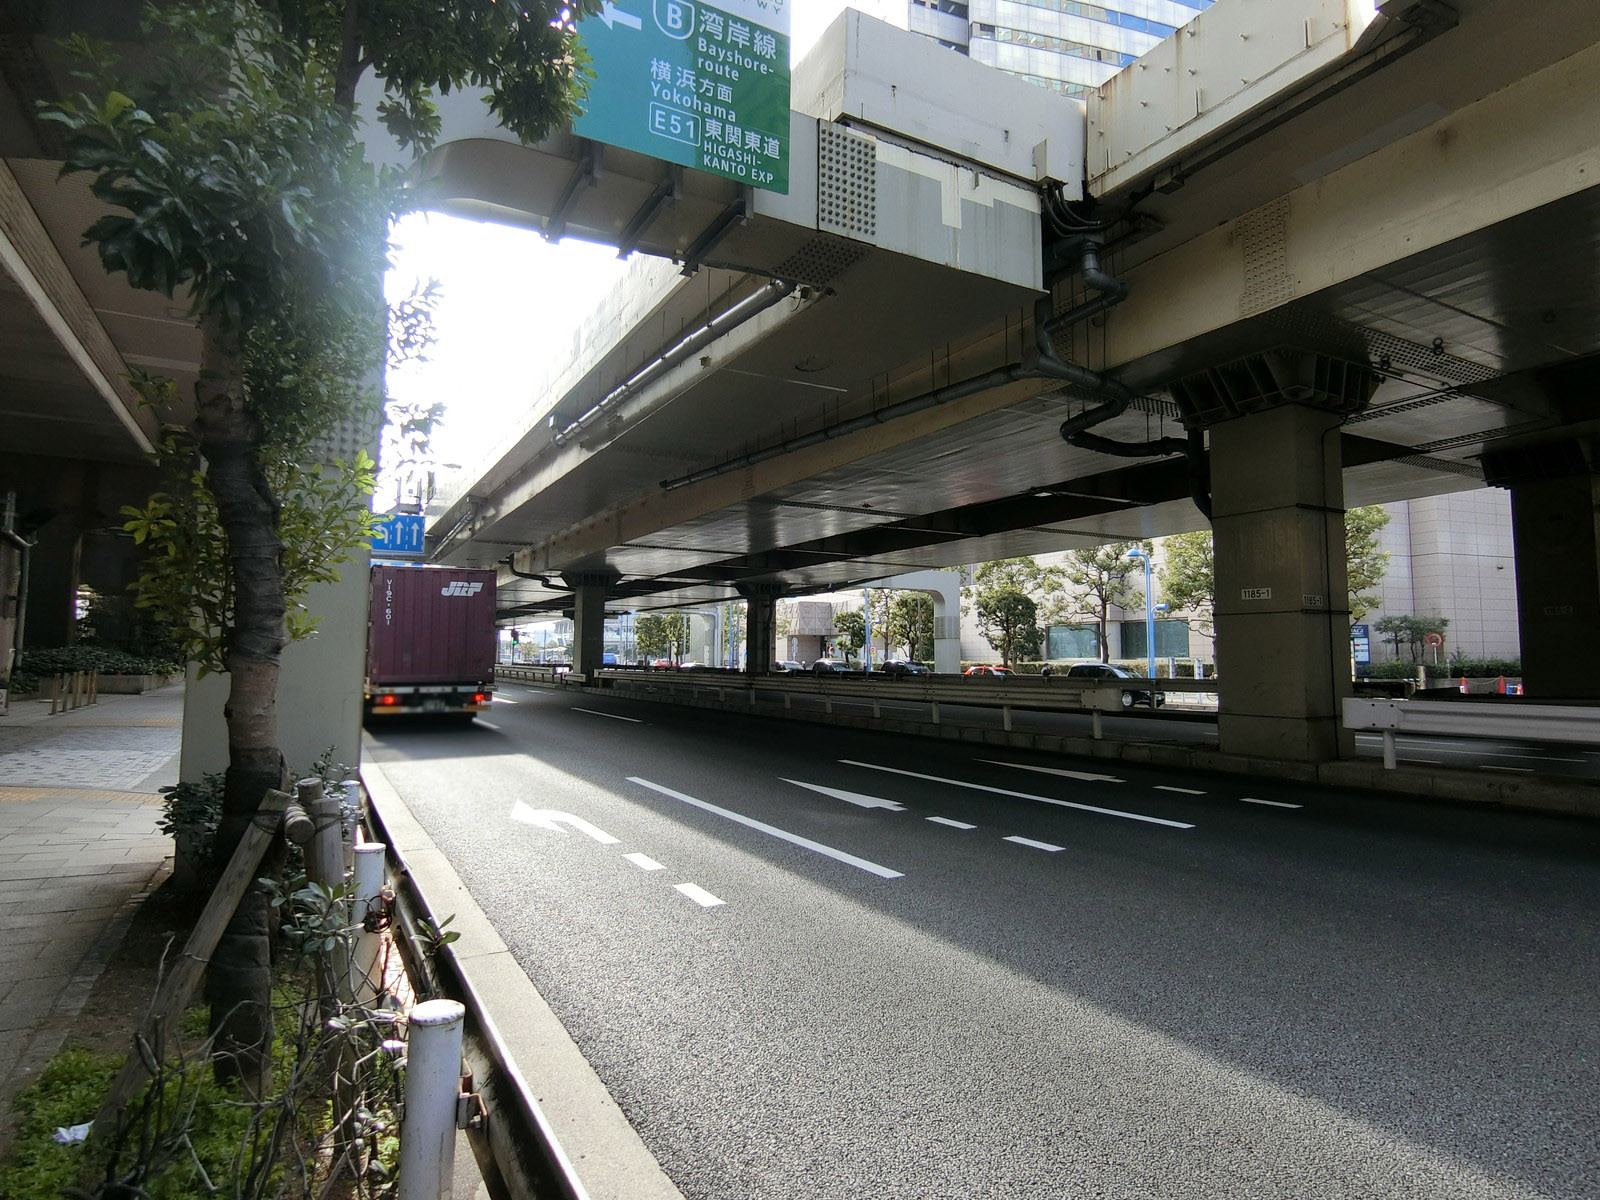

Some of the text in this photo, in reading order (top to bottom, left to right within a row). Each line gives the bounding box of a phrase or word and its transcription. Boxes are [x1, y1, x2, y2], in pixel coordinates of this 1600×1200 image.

[666, 3, 683, 30] B
[699, 8, 777, 60] 湾岸線
[698, 37, 774, 75] Bayshore-
[698, 57, 740, 82] route
[650, 57, 733, 104] 横浜方面
[650, 81, 736, 122] Yokohama
[655, 109, 694, 139] E51
[704, 117, 780, 160] 東関東道
[704, 140, 762, 166] HIGASHI-
[703, 154, 774, 184] KANTO EXP
[441, 581, 483, 597] JRF
[1243, 589, 1270, 599] 1185-1
[1303, 596, 1323, 605] 1185-1
